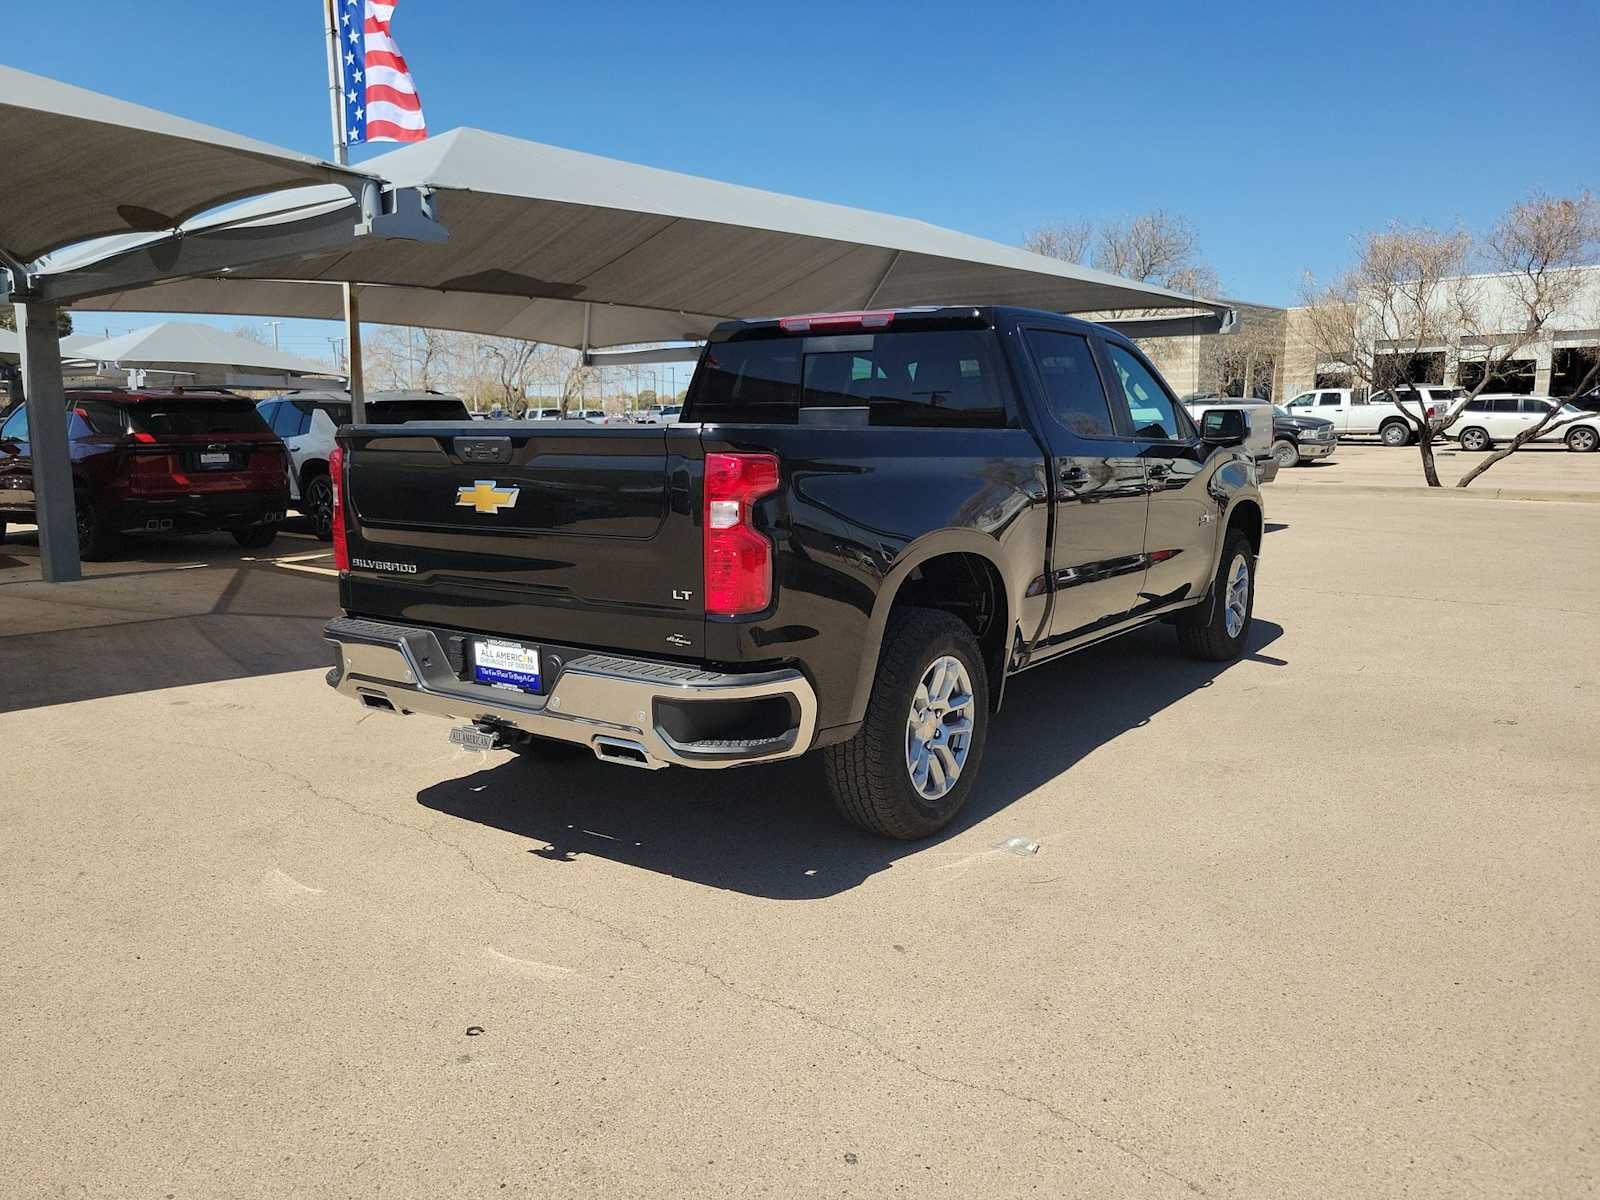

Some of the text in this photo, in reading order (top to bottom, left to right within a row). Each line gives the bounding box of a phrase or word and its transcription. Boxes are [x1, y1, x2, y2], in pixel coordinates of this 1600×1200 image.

[352, 558, 417, 573] SILVERADO
[672, 590, 693, 600] LT
[480, 649, 494, 658] ALL
